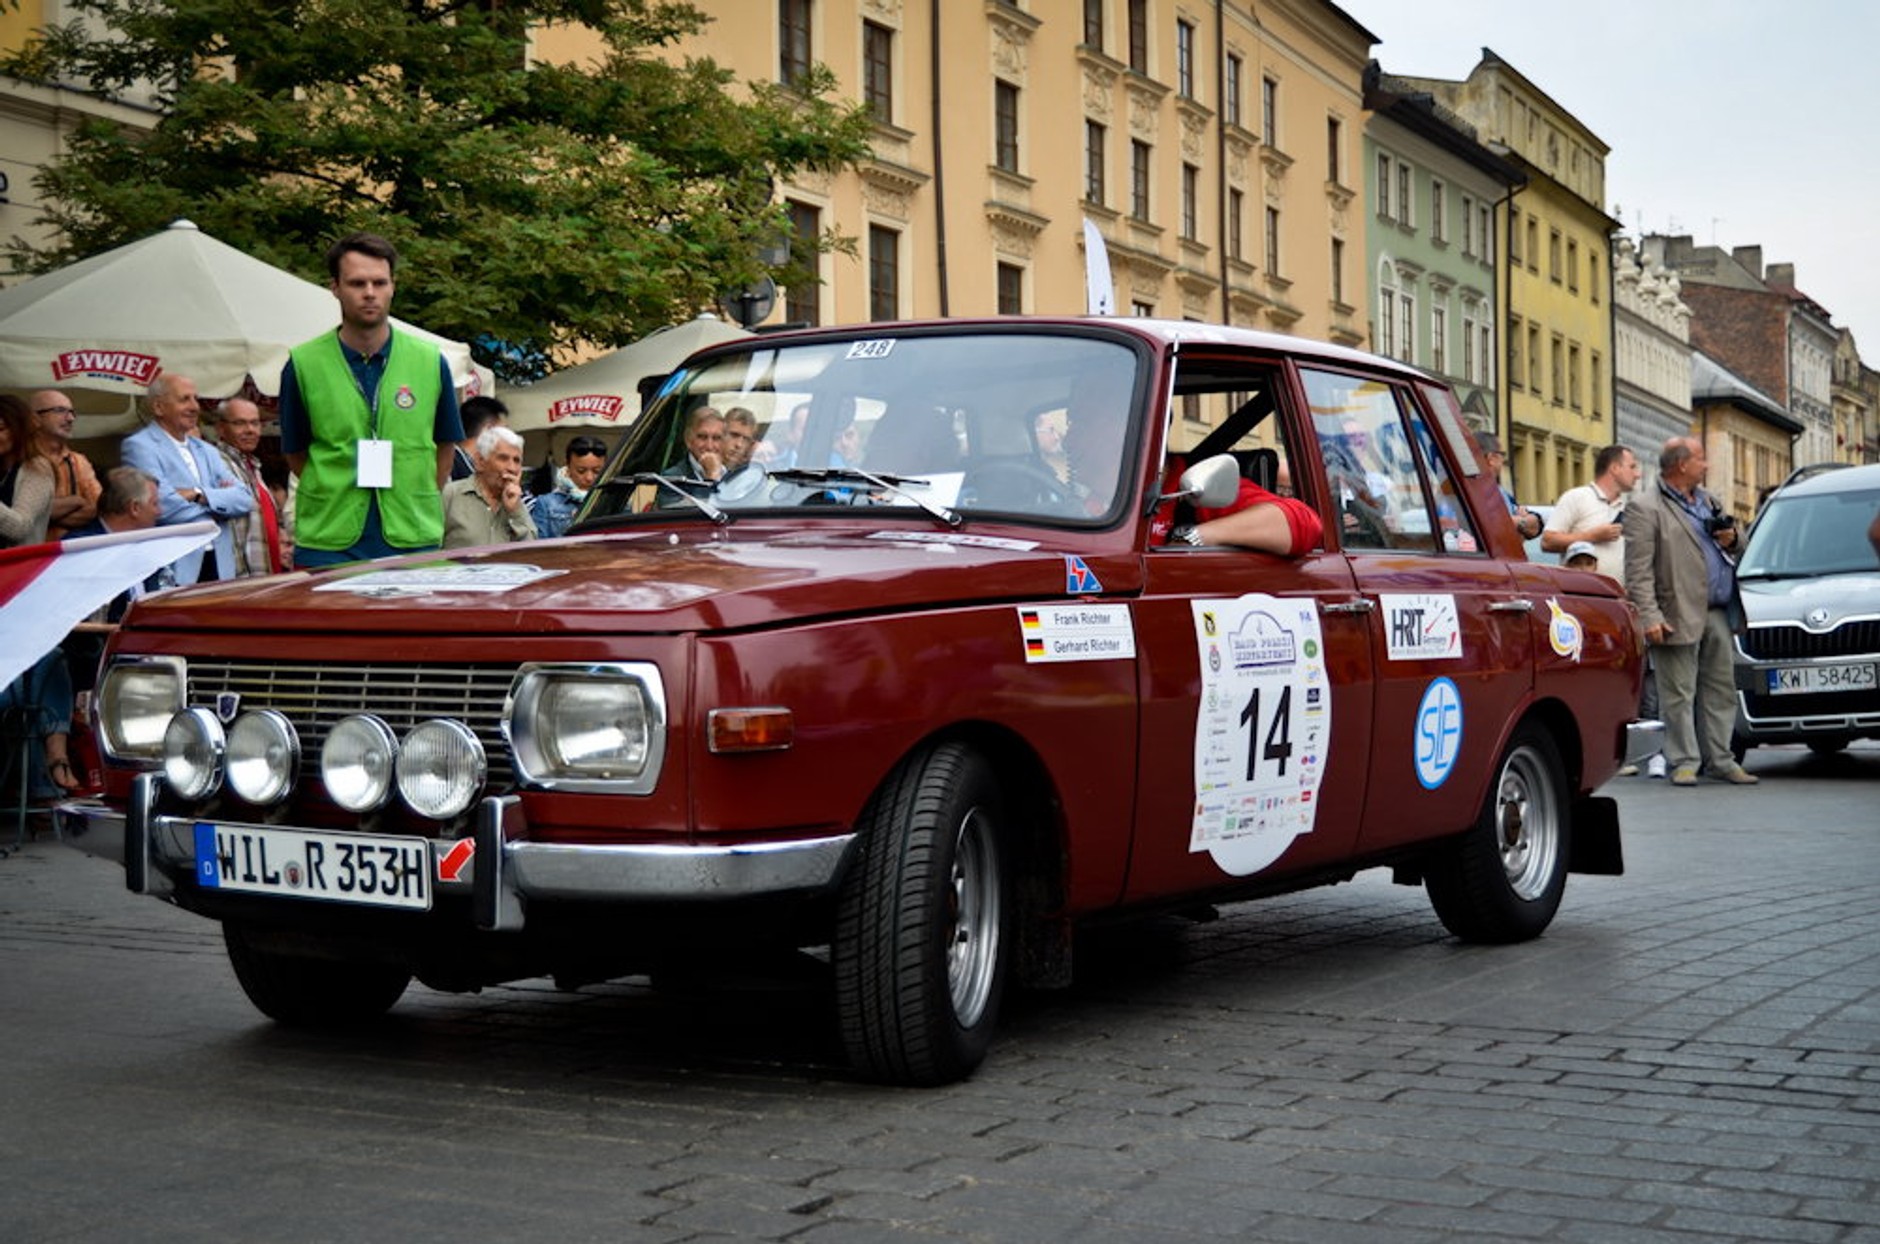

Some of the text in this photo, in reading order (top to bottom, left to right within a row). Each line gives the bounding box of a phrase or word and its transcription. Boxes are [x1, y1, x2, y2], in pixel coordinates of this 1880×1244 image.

[851, 340, 890, 357] 248
[66, 352, 152, 377] ŻYWIEC
[1054, 611, 1111, 625] Frank Richter
[1391, 608, 1425, 647] HRT
[1054, 639, 1121, 653] Gerhard Richter
[1779, 665, 1874, 689] KWI 58425
[1240, 684, 1293, 782] 14
[203, 860, 213, 876] D
[218, 832, 424, 898] WIL R 353H
